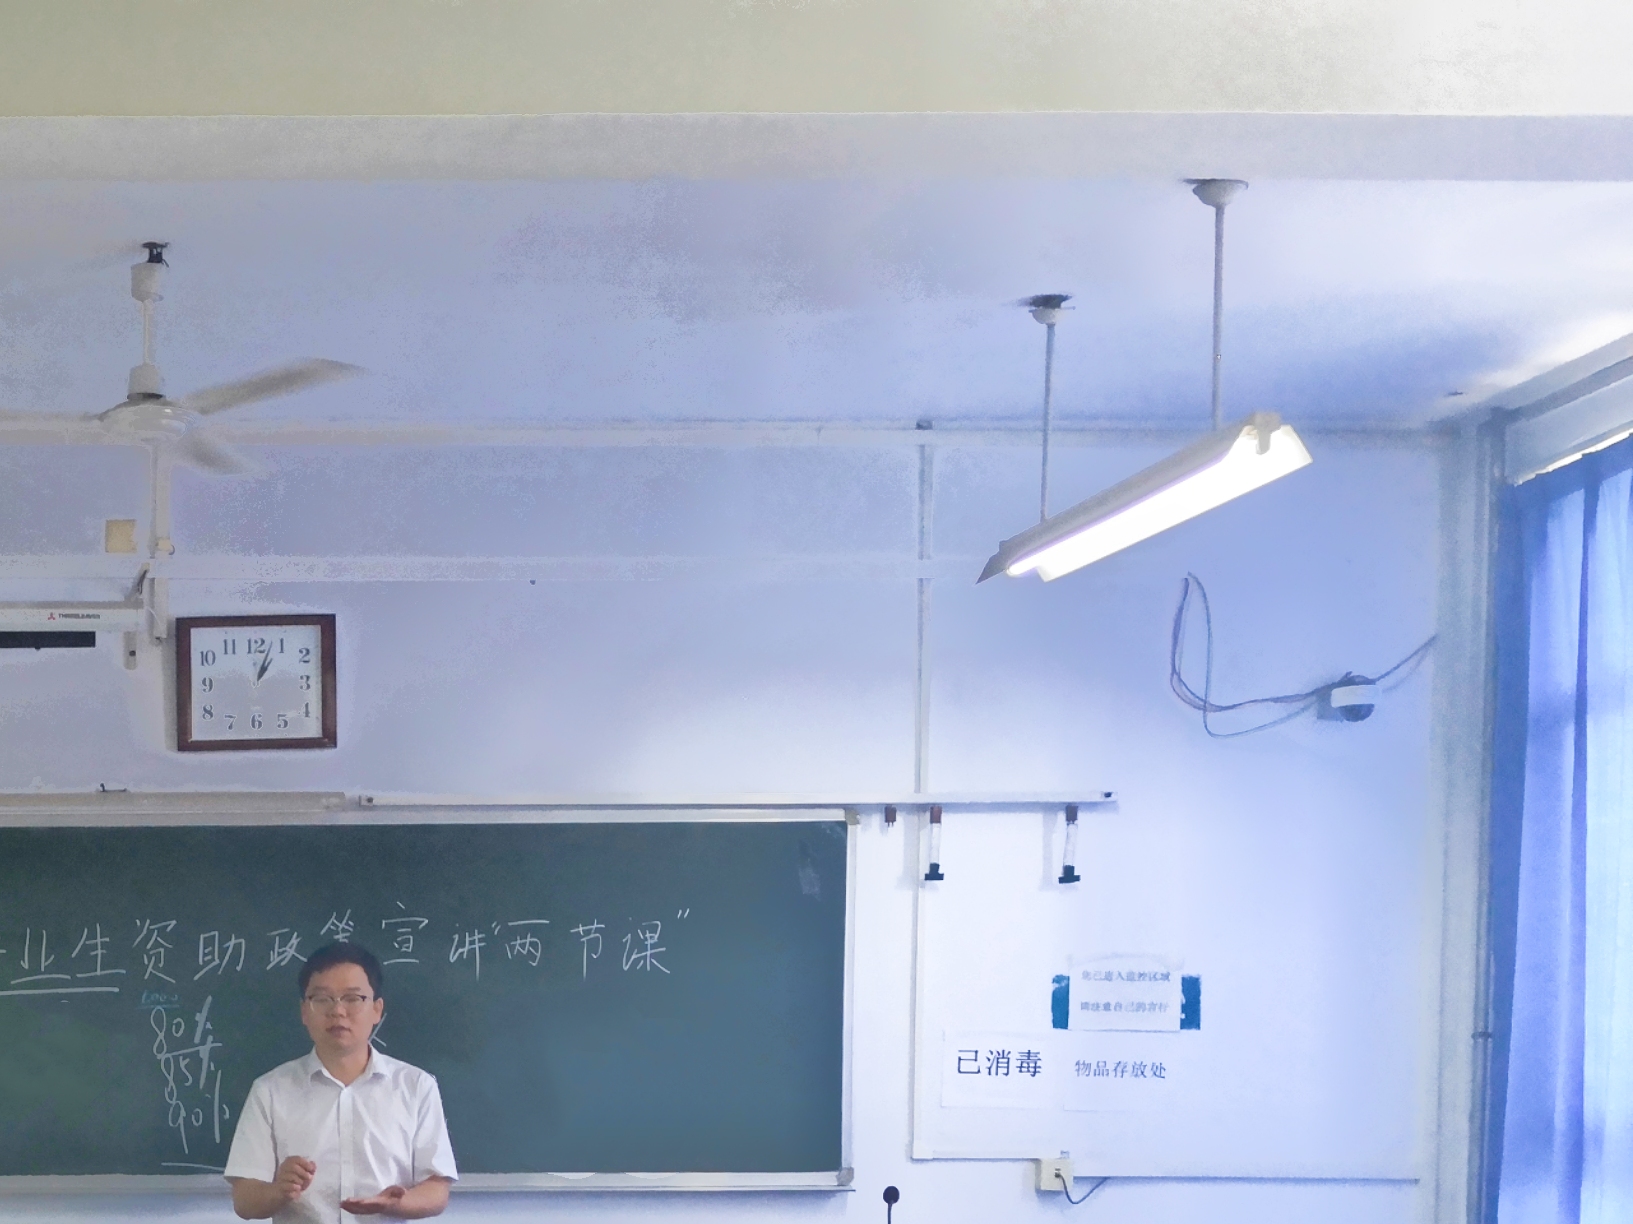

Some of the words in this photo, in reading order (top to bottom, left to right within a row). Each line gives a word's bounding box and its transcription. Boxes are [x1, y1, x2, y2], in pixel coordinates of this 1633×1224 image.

[223, 638, 237, 655] 11
[246, 637, 266, 654] 12
[278, 637, 286, 654] 1
[200, 650, 216, 666] 10
[298, 647, 311, 664] 2
[201, 677, 214, 693] 9
[299, 674, 311, 691] 3
[202, 704, 214, 720] 8
[224, 714, 237, 731] 7
[250, 713, 263, 730] 6
[277, 713, 289, 729] 5
[957, 1049, 1042, 1077] 已消毒
[1075, 1059, 1167, 1079] 物品存放处
